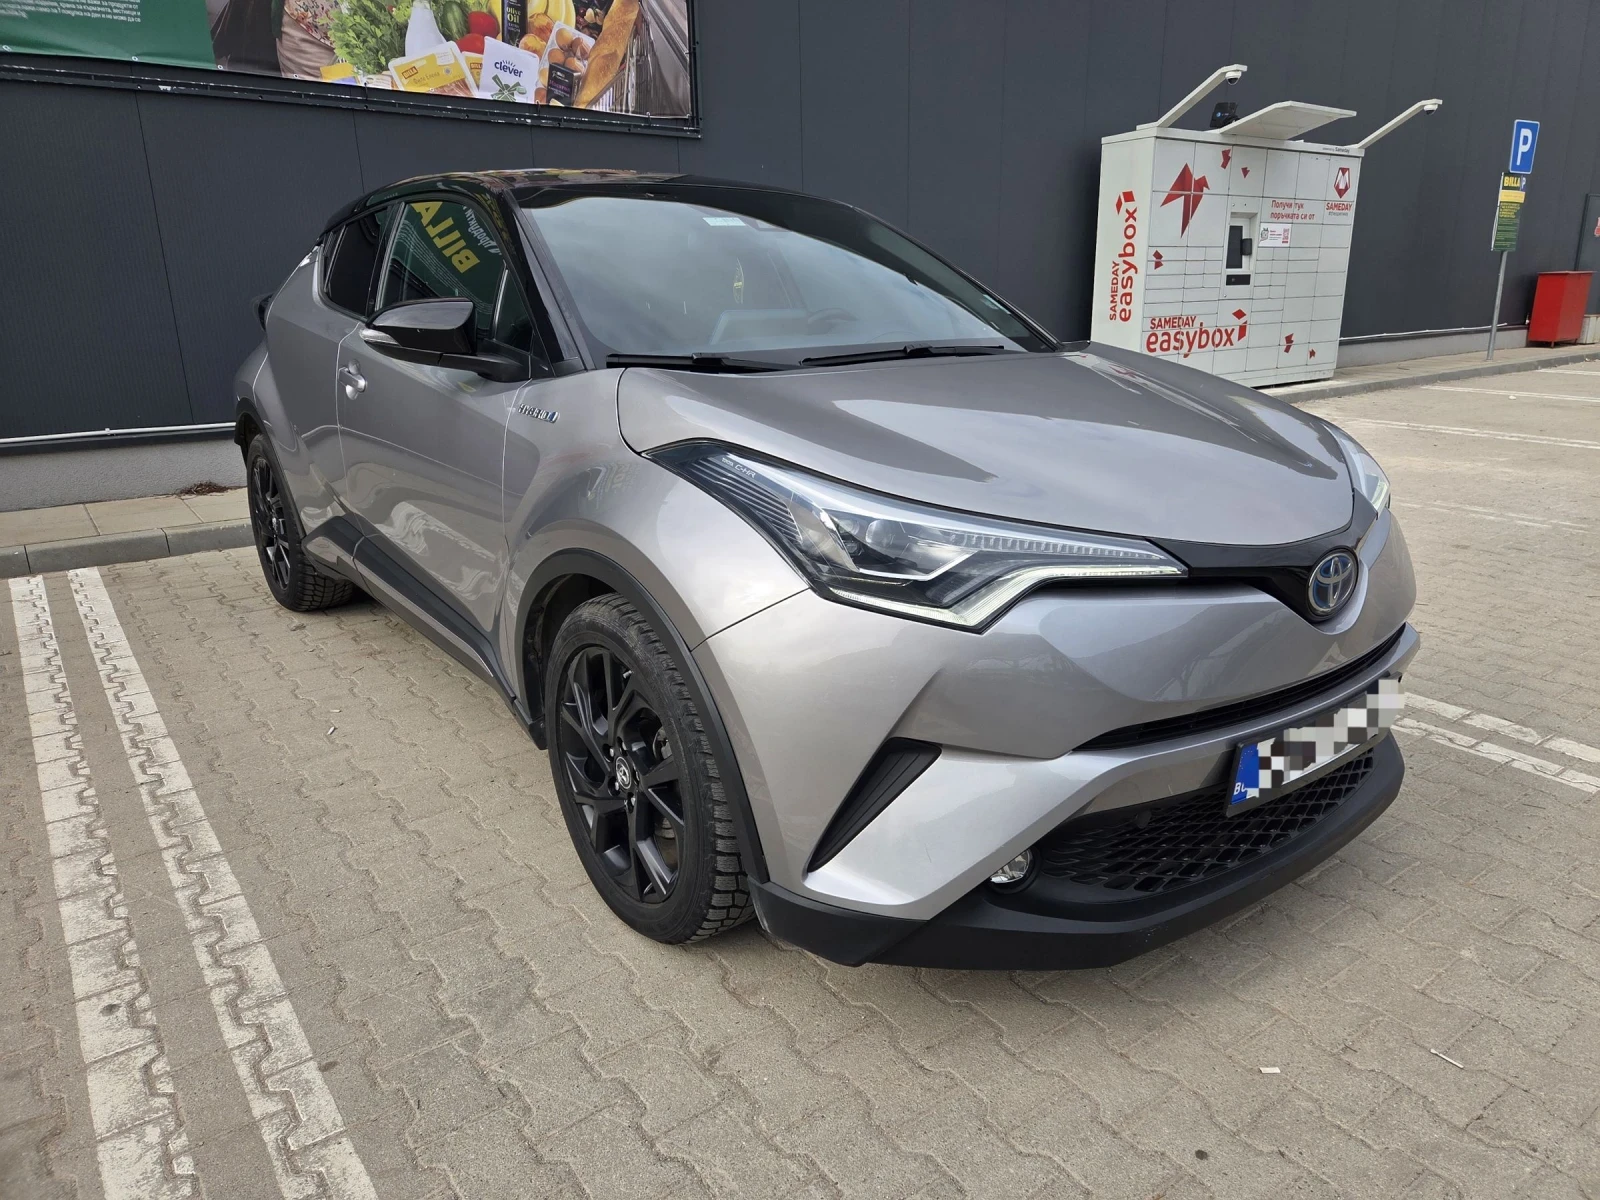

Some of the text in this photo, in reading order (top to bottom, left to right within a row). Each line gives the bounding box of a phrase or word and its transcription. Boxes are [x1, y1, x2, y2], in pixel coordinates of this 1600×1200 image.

[507, 13, 520, 23] Oil
[494, 61, 523, 78] clever
[1516, 128, 1533, 166] P
[1504, 176, 1521, 187] BILLA
[1271, 200, 1304, 211] Получи тук
[1325, 202, 1353, 211] SAMEDAY
[1270, 212, 1299, 220] поръчката
[1308, 212, 1315, 220] от
[1118, 207, 1138, 322] easybox
[1109, 261, 1120, 321] SAMEDAY
[1150, 315, 1197, 330] SAMEDAY
[1146, 321, 1236, 359] easybox
[734, 464, 756, 479] C-HR
